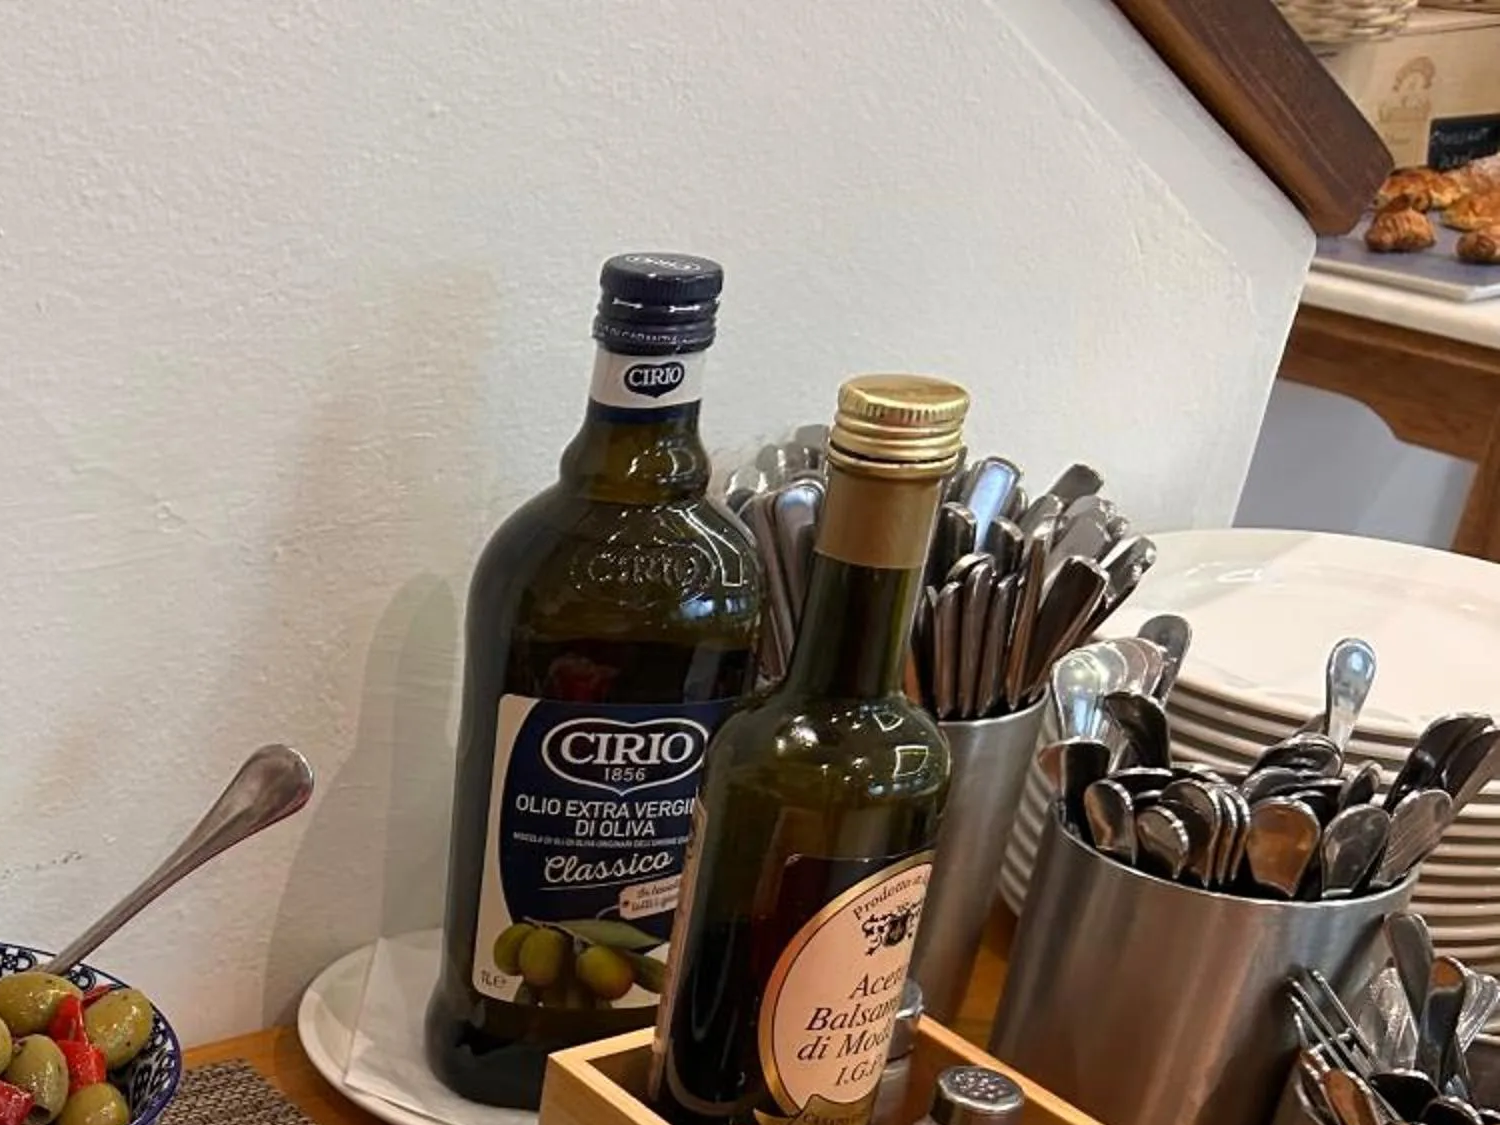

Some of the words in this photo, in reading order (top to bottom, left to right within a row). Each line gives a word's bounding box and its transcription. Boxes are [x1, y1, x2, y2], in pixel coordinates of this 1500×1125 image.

[628, 364, 683, 386] CIRIO
[560, 731, 694, 765] CIRIO
[603, 767, 646, 782] 1856
[515, 793, 561, 815] OLIO
[565, 800, 629, 818] EXTRA
[574, 820, 596, 837] DI
[599, 820, 656, 838] OLIVA
[543, 851, 674, 883] Classico
[797, 1035, 831, 1061] di
